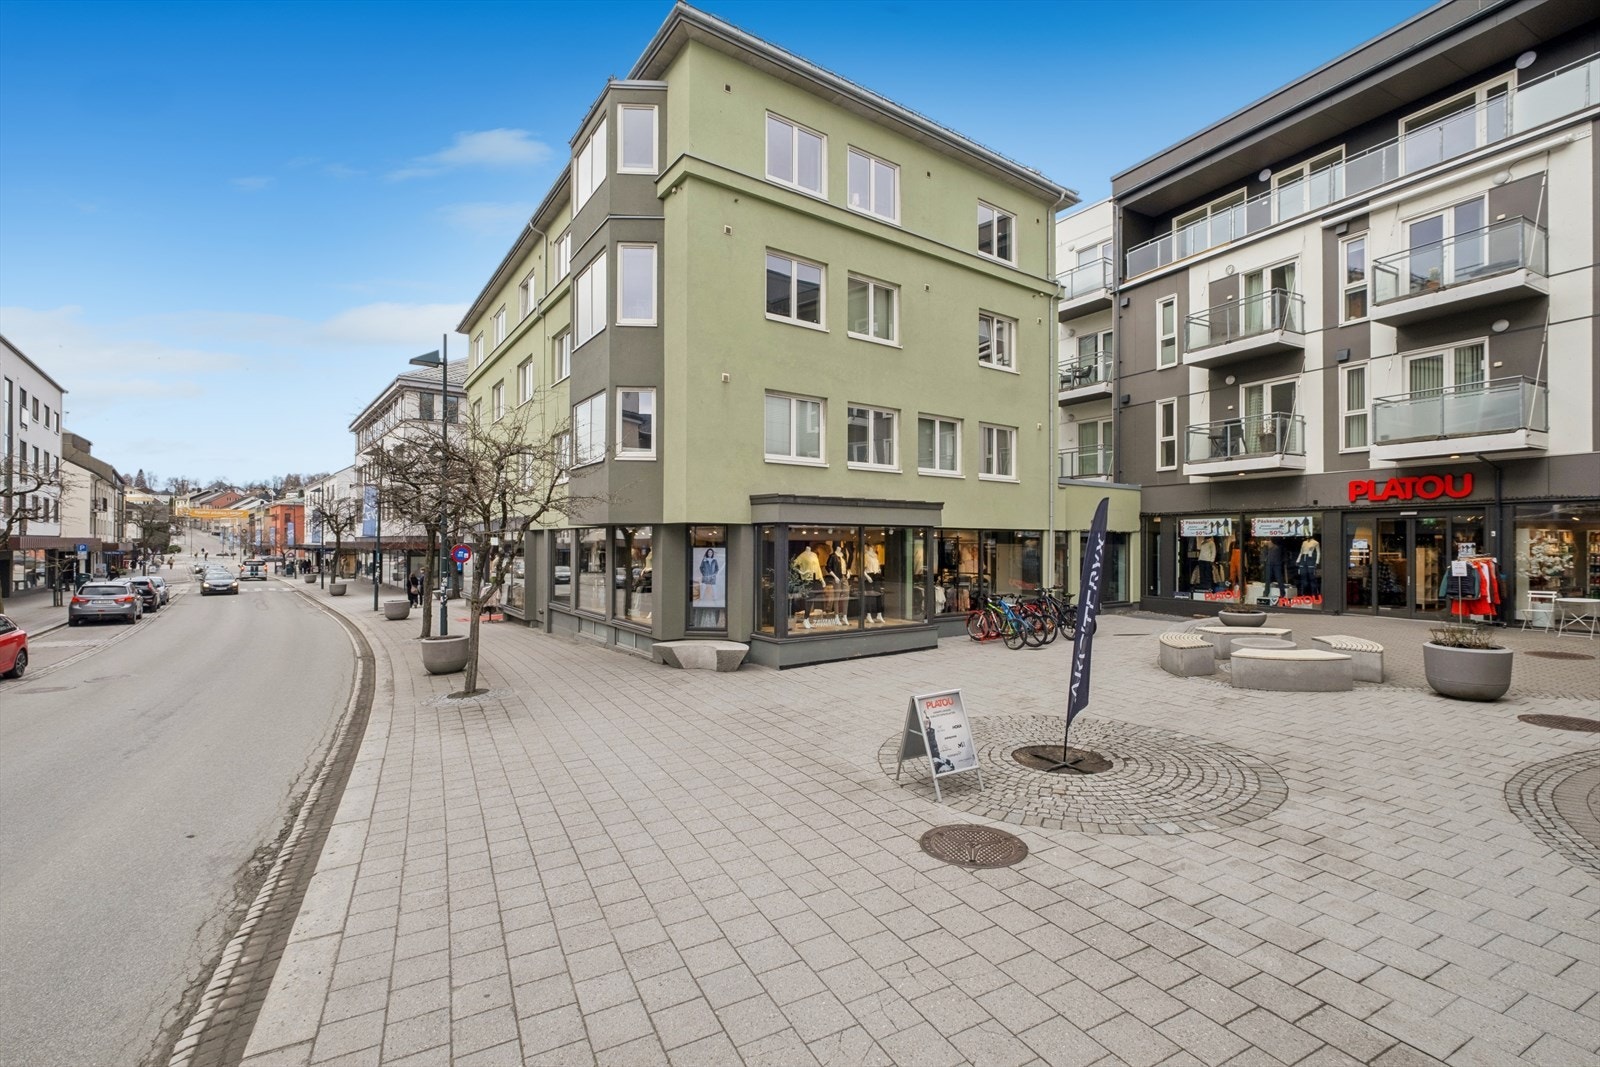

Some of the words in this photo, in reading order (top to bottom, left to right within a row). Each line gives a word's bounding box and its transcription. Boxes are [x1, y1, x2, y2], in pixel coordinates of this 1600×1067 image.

[1348, 472, 1473, 502] PLATOU
[1204, 589, 1241, 601] PLATOU
[1279, 595, 1323, 608] PLATOU
[926, 697, 954, 709] PLATOU
